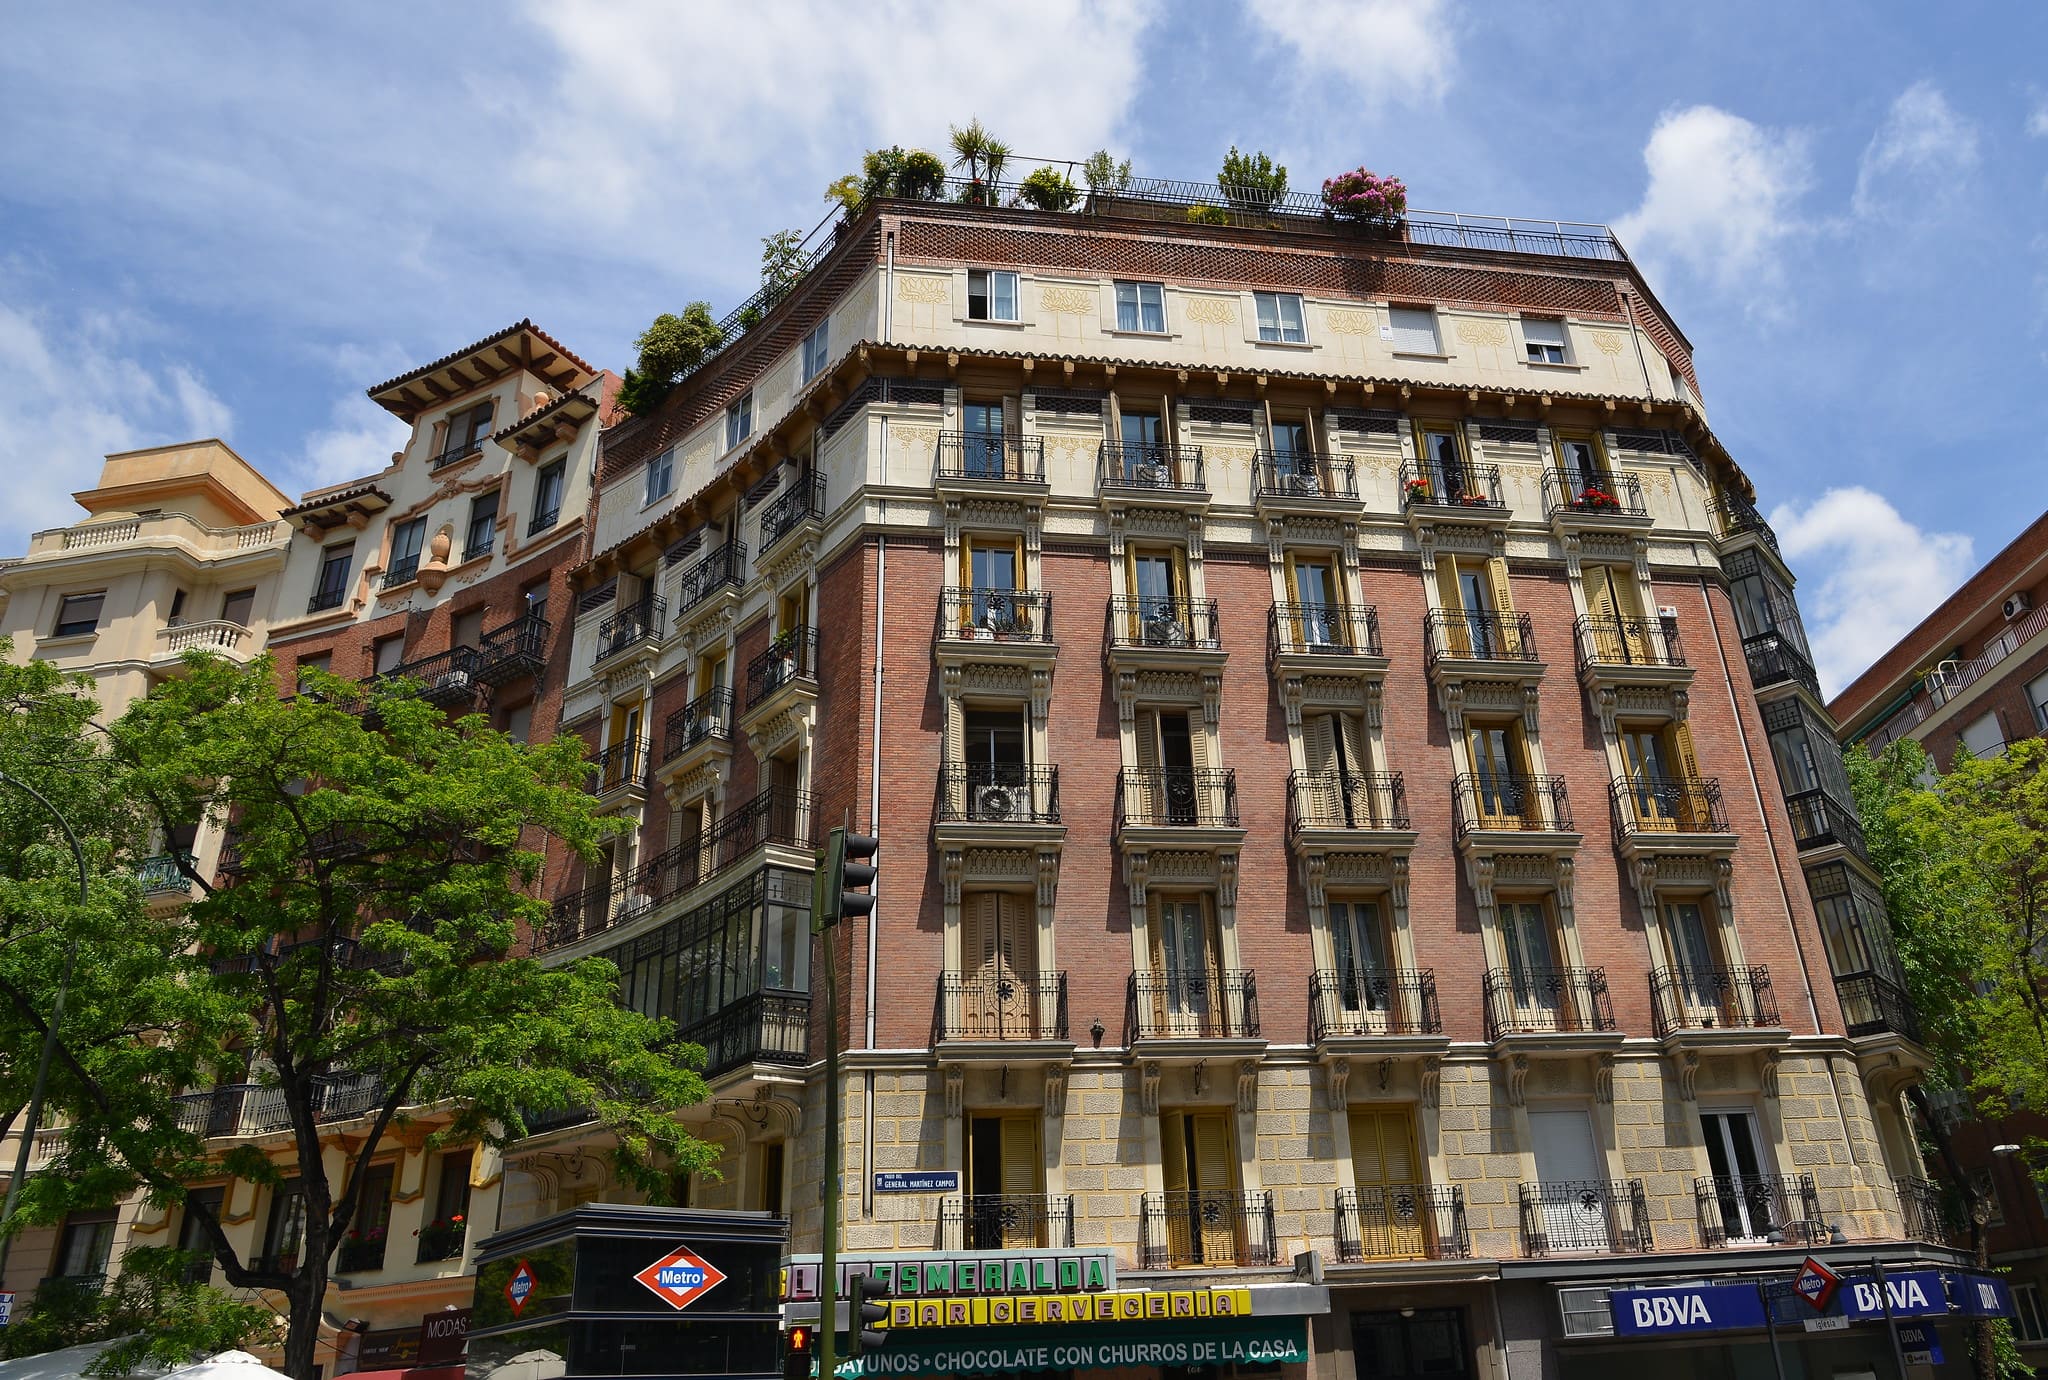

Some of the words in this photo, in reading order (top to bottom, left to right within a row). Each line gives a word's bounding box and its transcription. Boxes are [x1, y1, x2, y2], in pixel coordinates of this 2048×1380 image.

[884, 1180, 908, 1189] GENERAL
[909, 1178, 934, 1188] MARTÍNEZ
[935, 1179, 955, 1188] CAMPOS
[661, 1269, 701, 1285] Metro
[1801, 1278, 1821, 1291] Metro
[512, 1279, 529, 1295] Metro
[895, 1303, 966, 1325] BAR
[994, 1293, 1232, 1322] CERVECERIA
[1632, 1294, 1712, 1328] BBVA
[427, 1316, 467, 1339] MODAS
[1815, 1318, 1837, 1330] Iglesia
[1899, 1328, 1926, 1343] BBVA
[934, 1347, 1049, 1371] CHOCOLATE
[1053, 1346, 1093, 1365] CON
[1098, 1343, 1188, 1364] CHURROS
[1193, 1342, 1217, 1361] DE
[1222, 1340, 1245, 1359] LA
[1248, 1338, 1298, 1359] CASA
